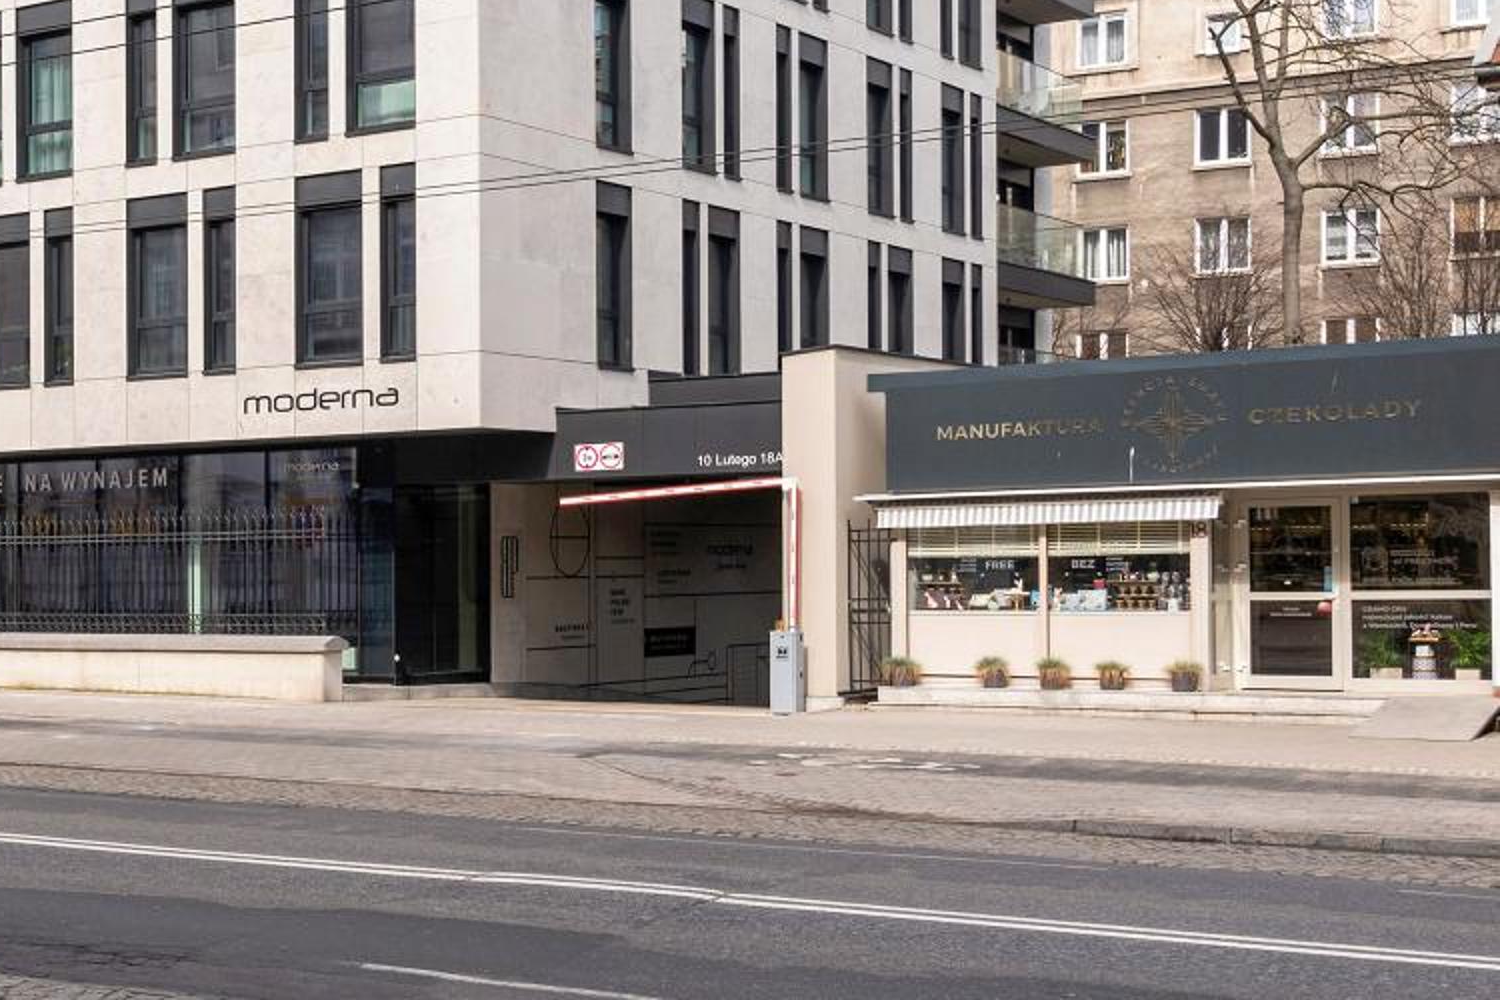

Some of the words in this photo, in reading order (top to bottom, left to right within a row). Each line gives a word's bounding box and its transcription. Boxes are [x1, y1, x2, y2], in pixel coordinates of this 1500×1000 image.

[243, 387, 400, 415] moderna
[936, 416, 1105, 441] MANUFAKTURA
[1250, 400, 1421, 425] CZEKOLADY
[697, 455, 711, 467] 10
[715, 454, 757, 469] Lutego
[25, 473, 52, 492] NA
[61, 467, 168, 490] WYNAJEM
